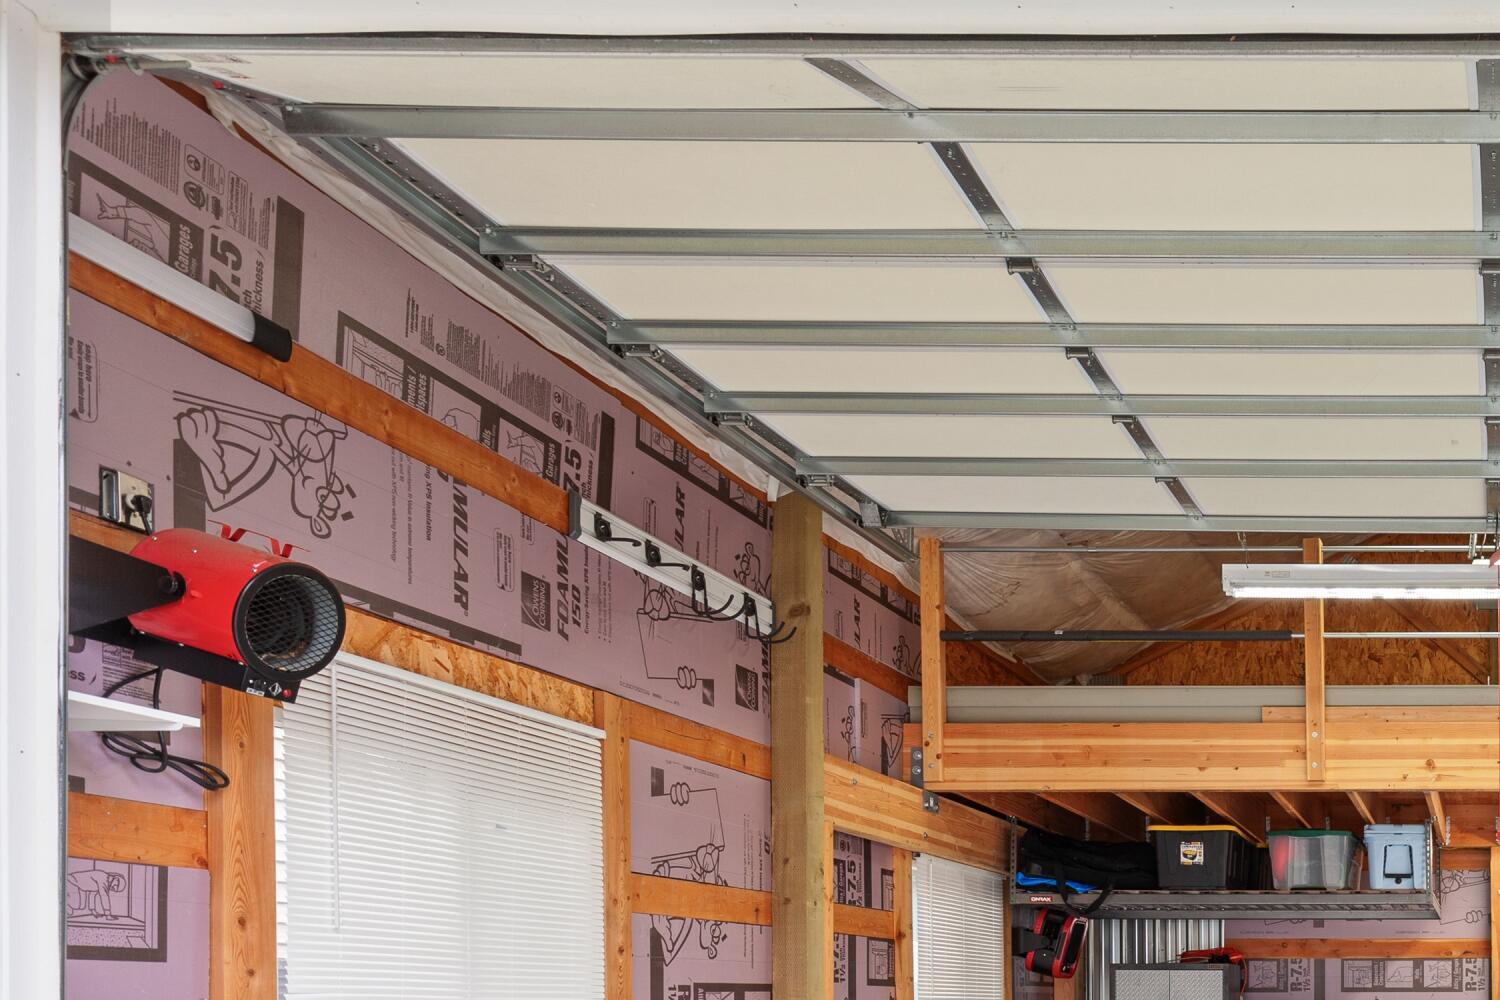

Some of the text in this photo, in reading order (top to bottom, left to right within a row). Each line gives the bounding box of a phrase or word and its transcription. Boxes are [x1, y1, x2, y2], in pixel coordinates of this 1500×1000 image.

[174, 223, 193, 274] Garages
[208, 233, 242, 304] 7.5
[252, 260, 264, 314] hickness
[545, 443, 556, 478] Garages
[563, 446, 581, 493] 7.5
[453, 484, 469, 612] MULAR
[532, 580, 541, 616] OWENS
[571, 584, 581, 628] 150
